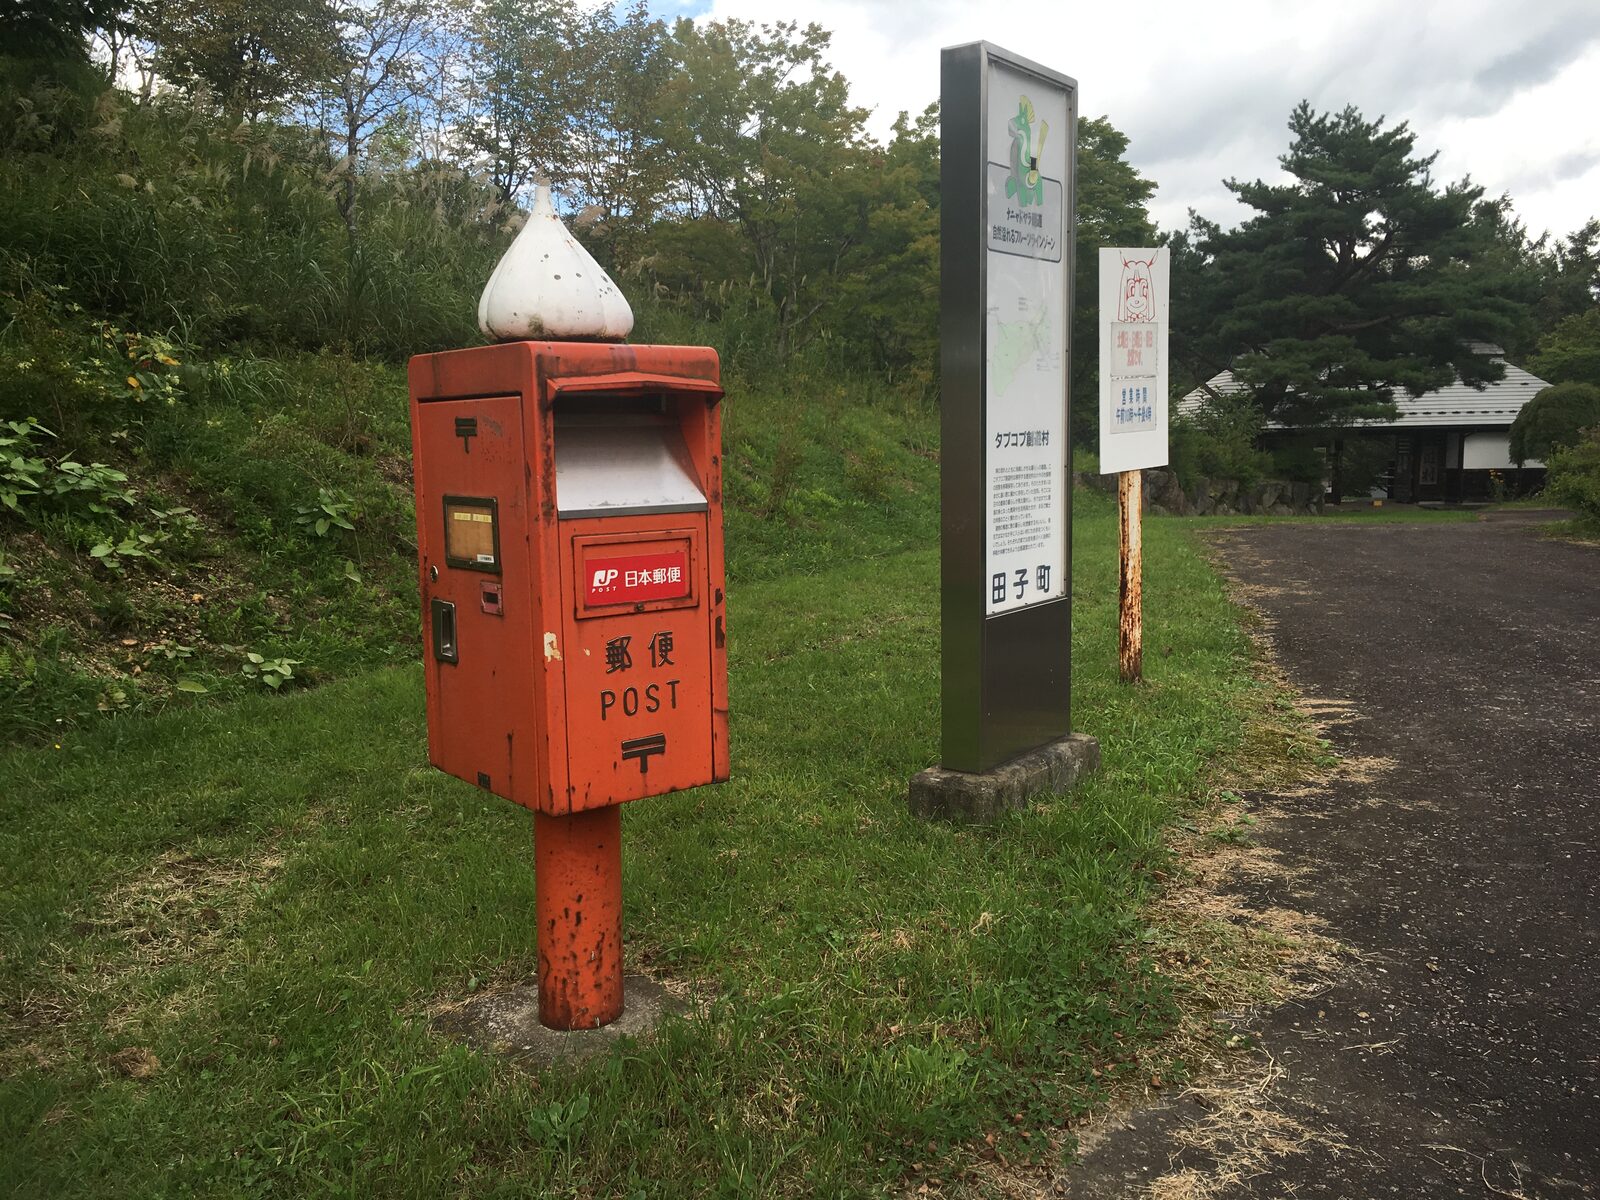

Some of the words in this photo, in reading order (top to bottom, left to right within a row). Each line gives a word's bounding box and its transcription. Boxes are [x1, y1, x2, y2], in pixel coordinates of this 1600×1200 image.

[625, 566, 681, 588] 日本郵便
[992, 565, 1051, 604] 田子町
[605, 631, 674, 674] 郵便
[601, 680, 680, 720] POST
